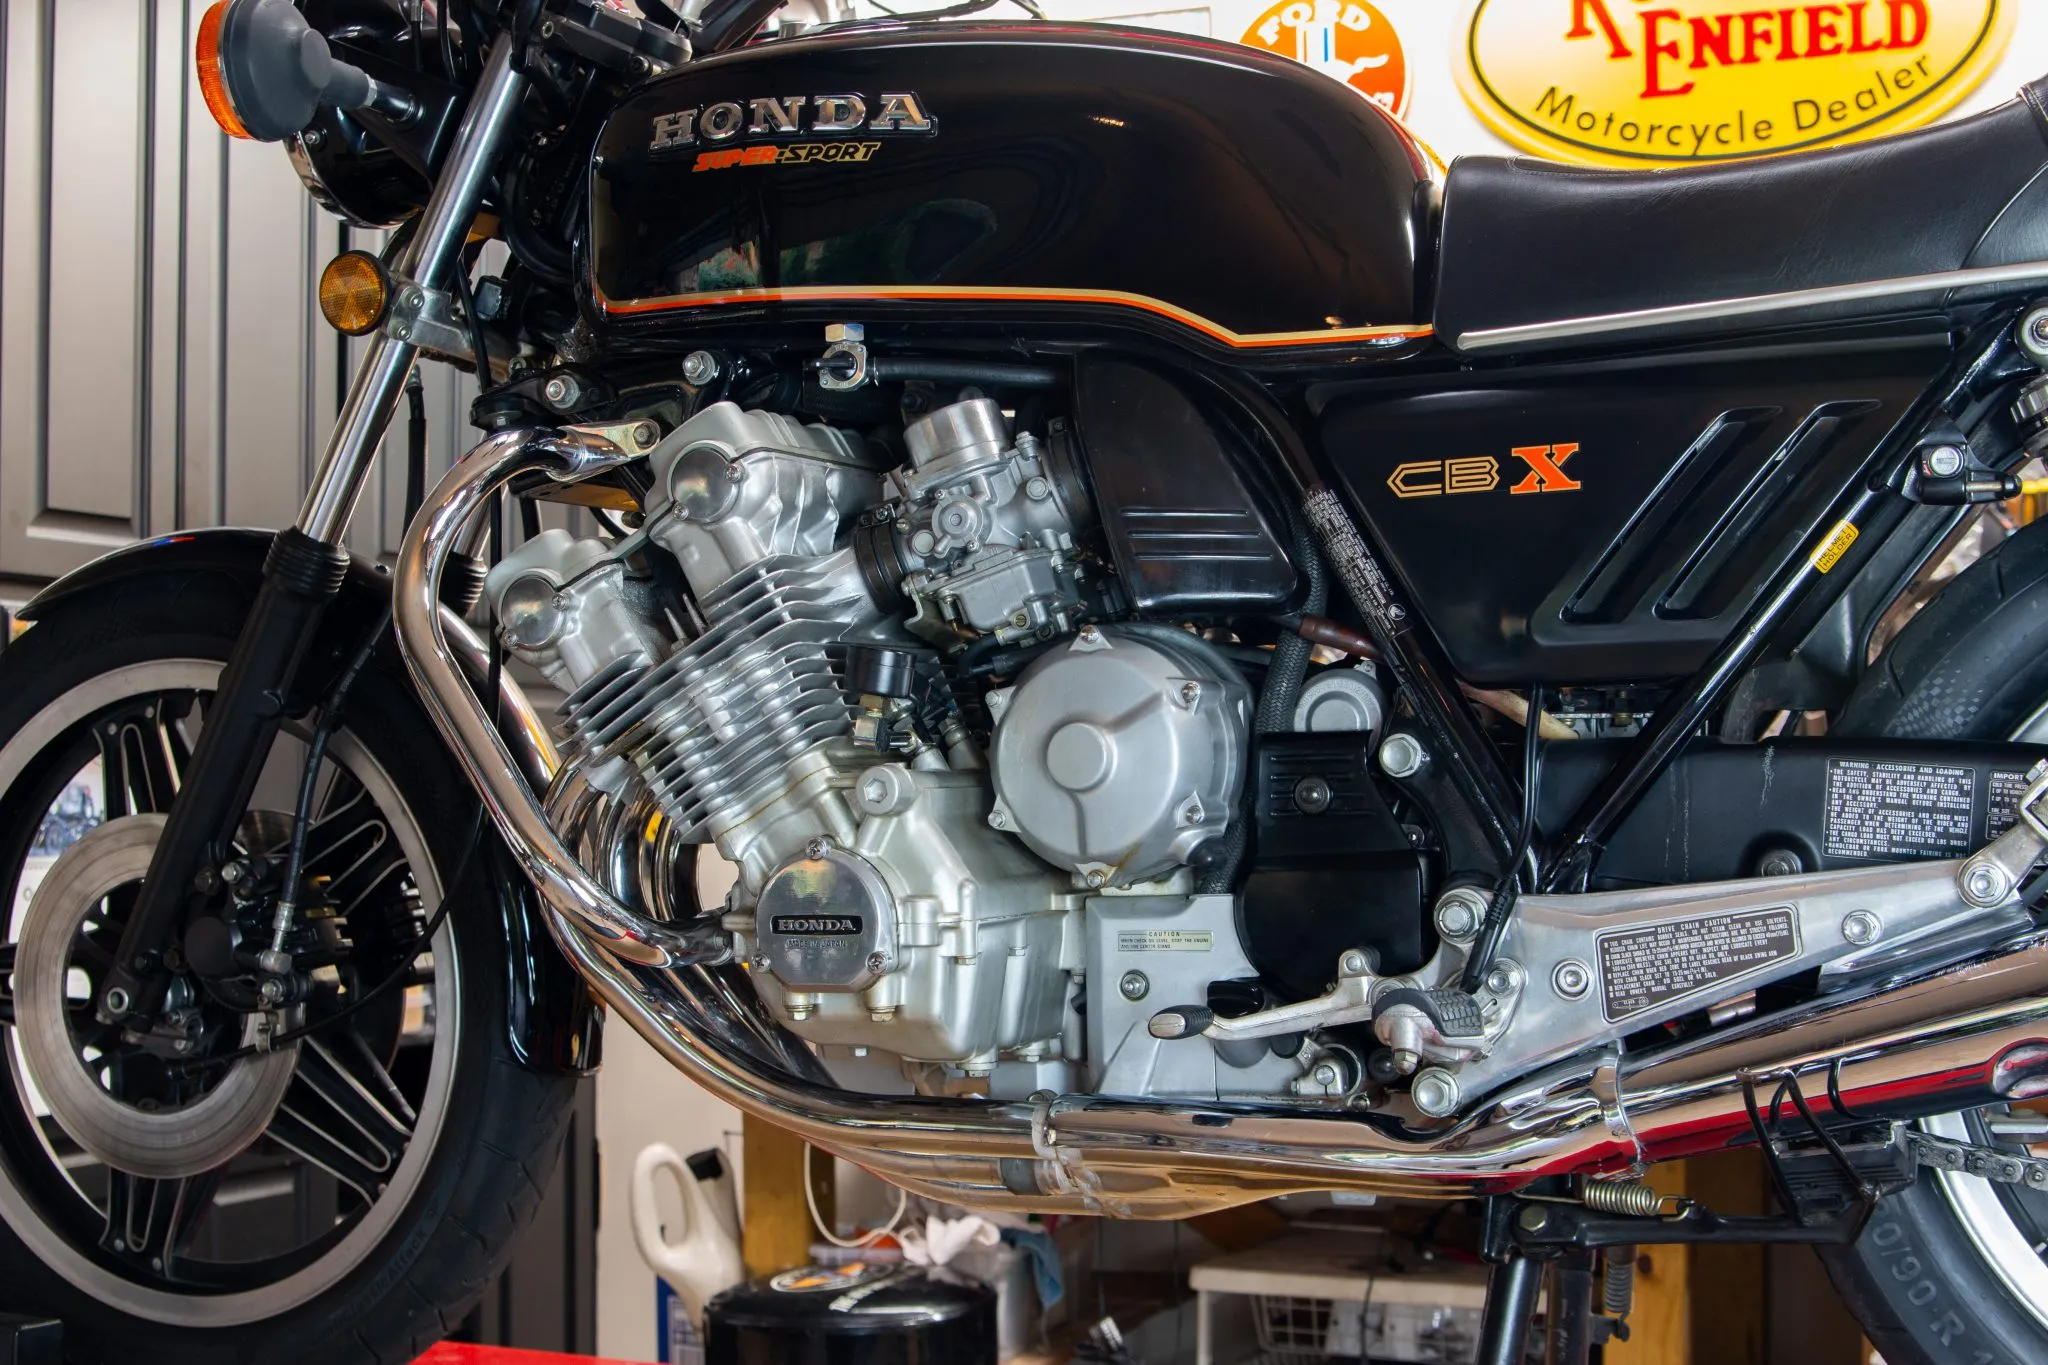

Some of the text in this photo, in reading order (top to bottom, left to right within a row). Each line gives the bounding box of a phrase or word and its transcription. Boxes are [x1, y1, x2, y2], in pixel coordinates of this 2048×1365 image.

[1257, 0, 1371, 46] FORD
[1640, 0, 1928, 99] ENFIELD
[650, 94, 933, 150] HONDA
[1536, 54, 1930, 156] Motorcycle Dealer
[1818, 529, 1847, 563] HELMET
[1822, 533, 1853, 567] HOLDER
[1839, 761, 1869, 769] WARNING
[1876, 763, 1916, 772] ACCESSORIES
[1935, 768, 1964, 776] LOADING
[778, 919, 856, 931] HONDA
[1657, 917, 1731, 934] DRIVE CHAIN CAUTION
